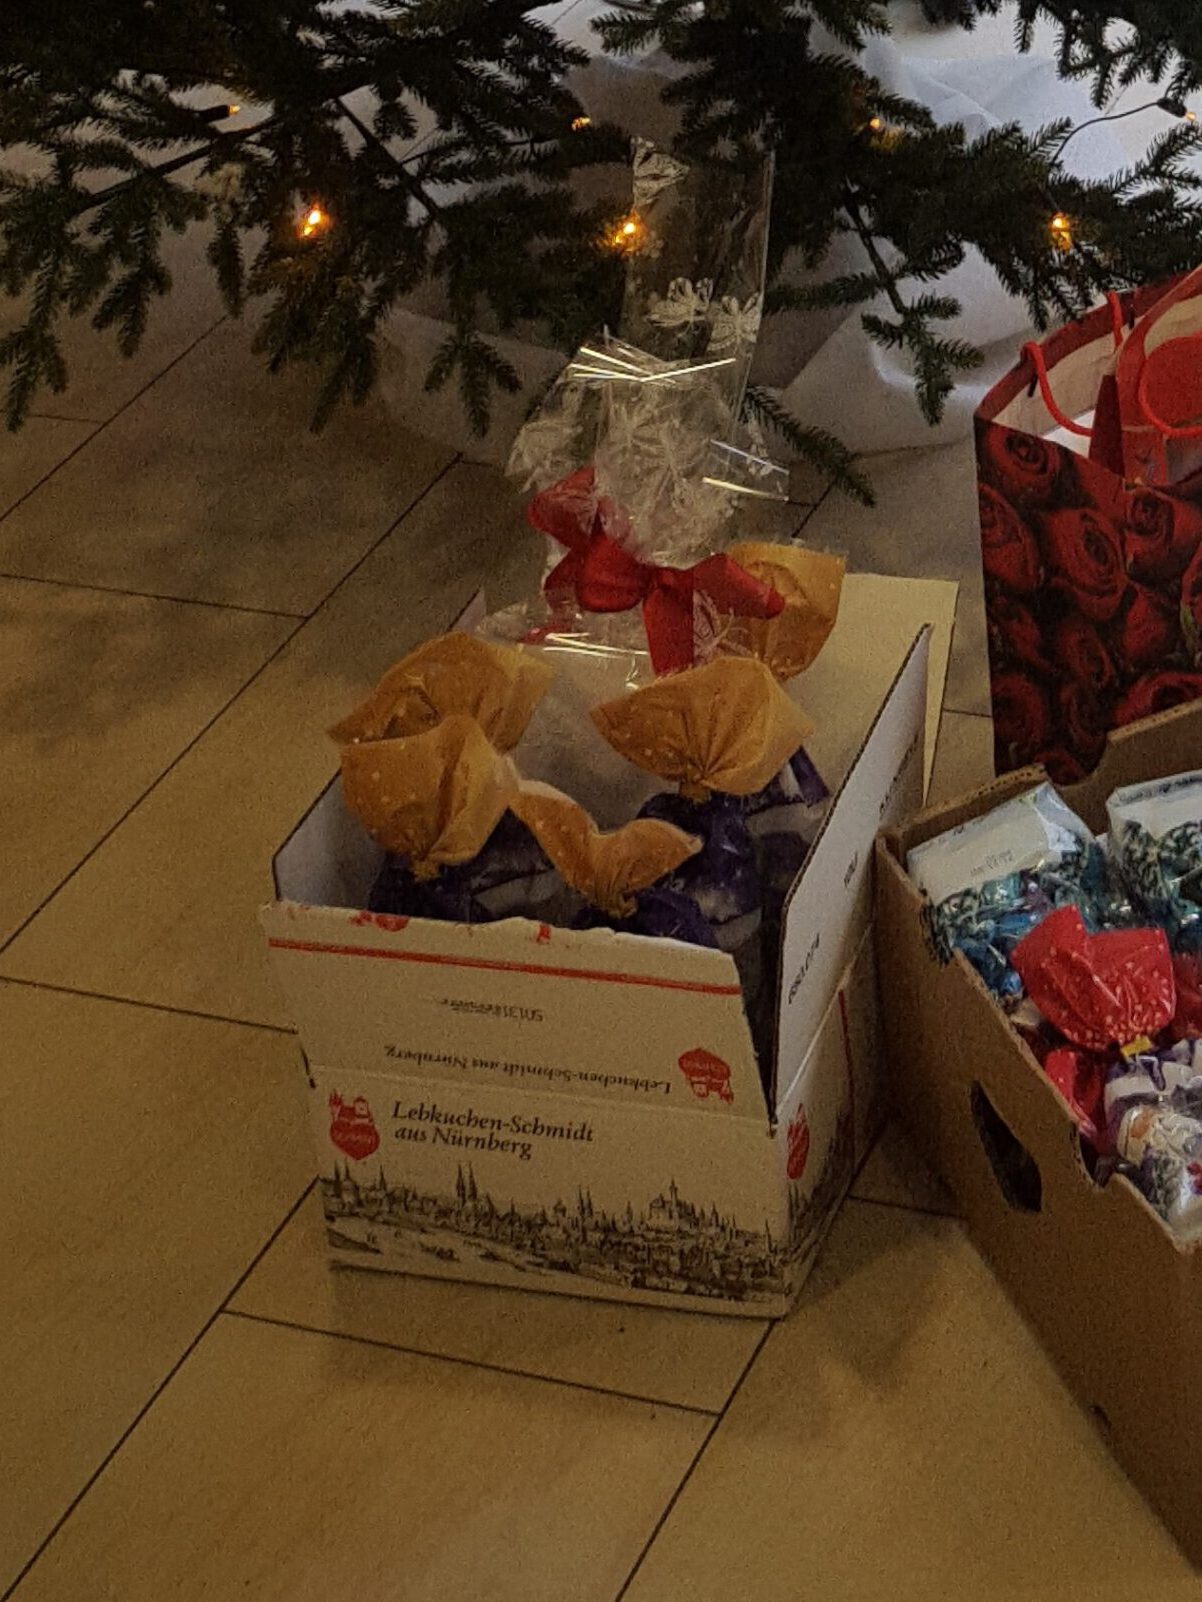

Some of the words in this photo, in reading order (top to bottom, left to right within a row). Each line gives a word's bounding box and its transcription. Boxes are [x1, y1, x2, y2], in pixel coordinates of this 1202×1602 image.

[383, 1044, 468, 1070] Nürnberg
[471, 1057, 500, 1071] aus
[502, 1061, 672, 1095] Lebkuchen-Schmidt
[391, 1100, 595, 1142] Lebkuchen-Schmidt
[394, 1125, 428, 1142] aus
[432, 1126, 534, 1161] Nürnberg
